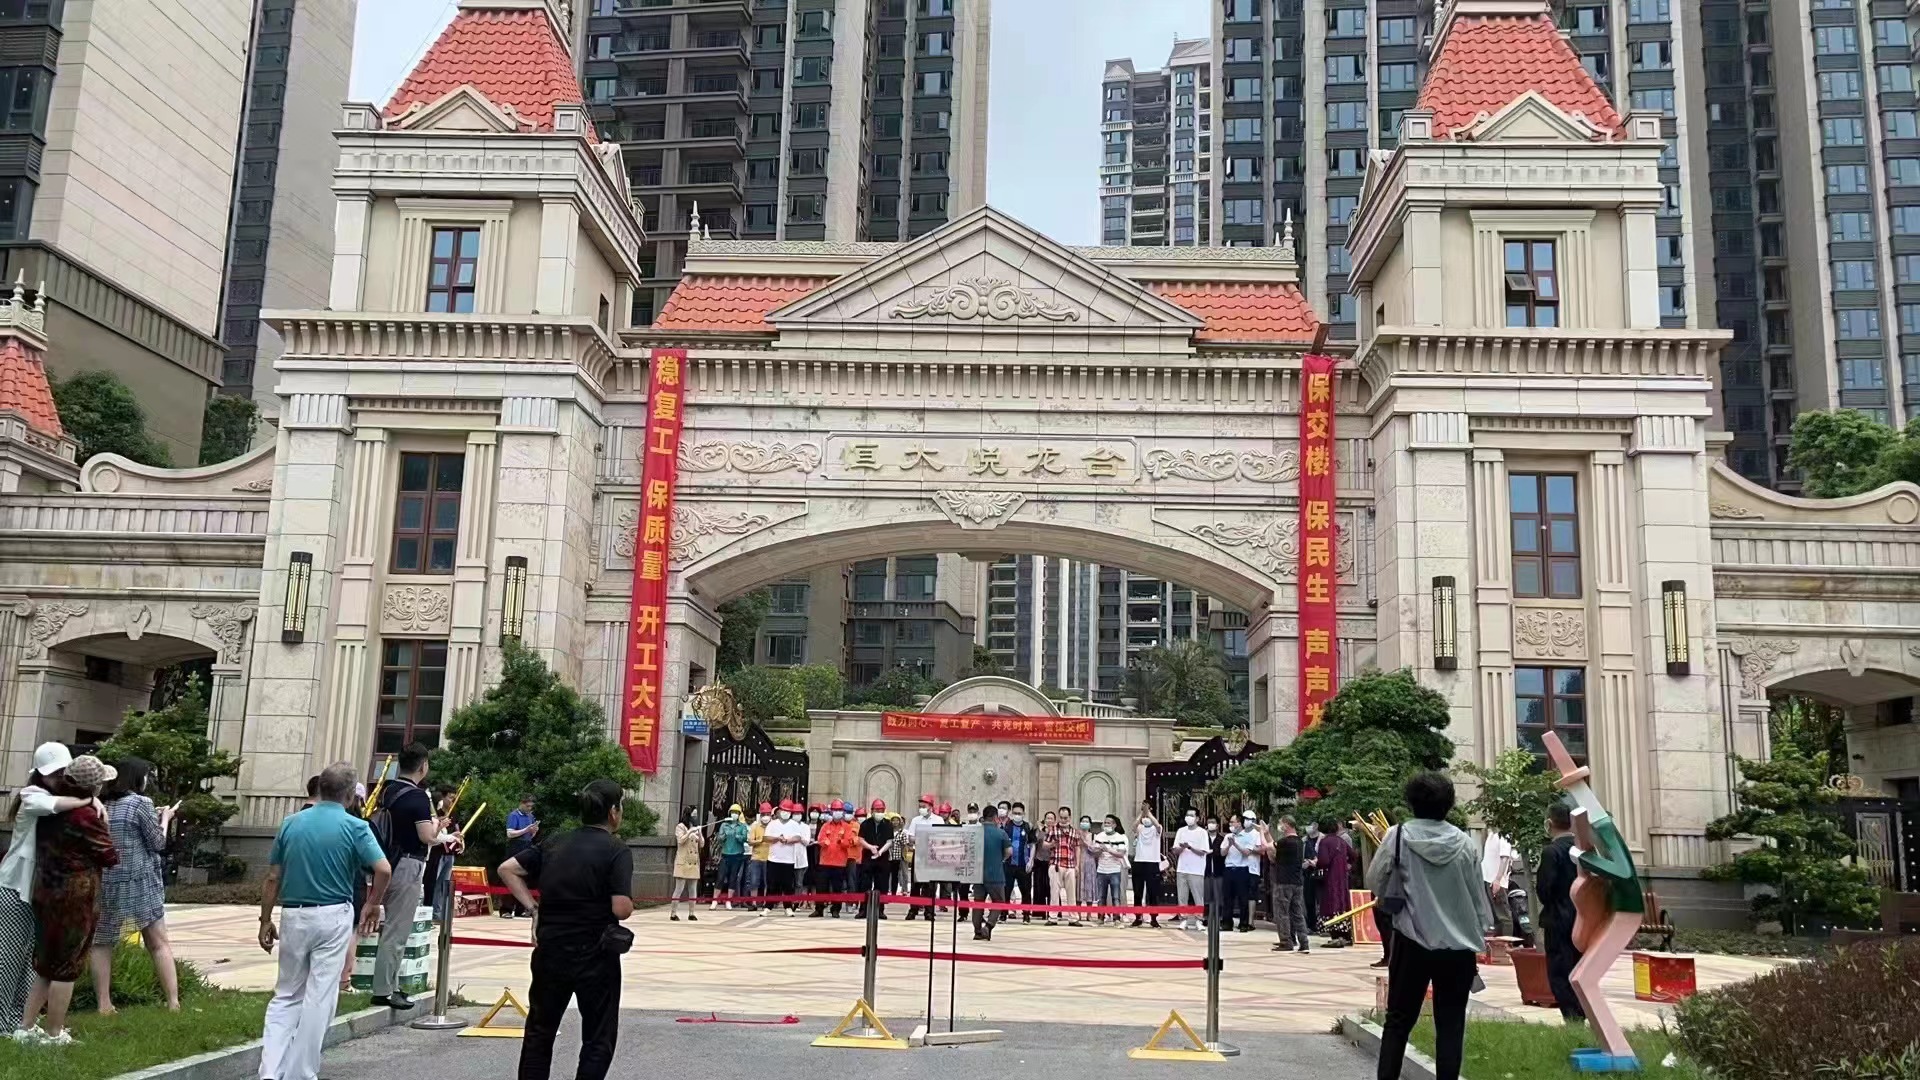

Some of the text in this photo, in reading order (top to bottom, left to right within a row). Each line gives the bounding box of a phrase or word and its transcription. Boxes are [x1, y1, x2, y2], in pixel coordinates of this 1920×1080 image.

[841, 442, 1126, 477] 恒大悦龙台
[1305, 373, 1330, 476] 保交楼
[628, 355, 680, 747] 稳复工 保质量 开工大吉
[1304, 500, 1330, 603] 保民生
